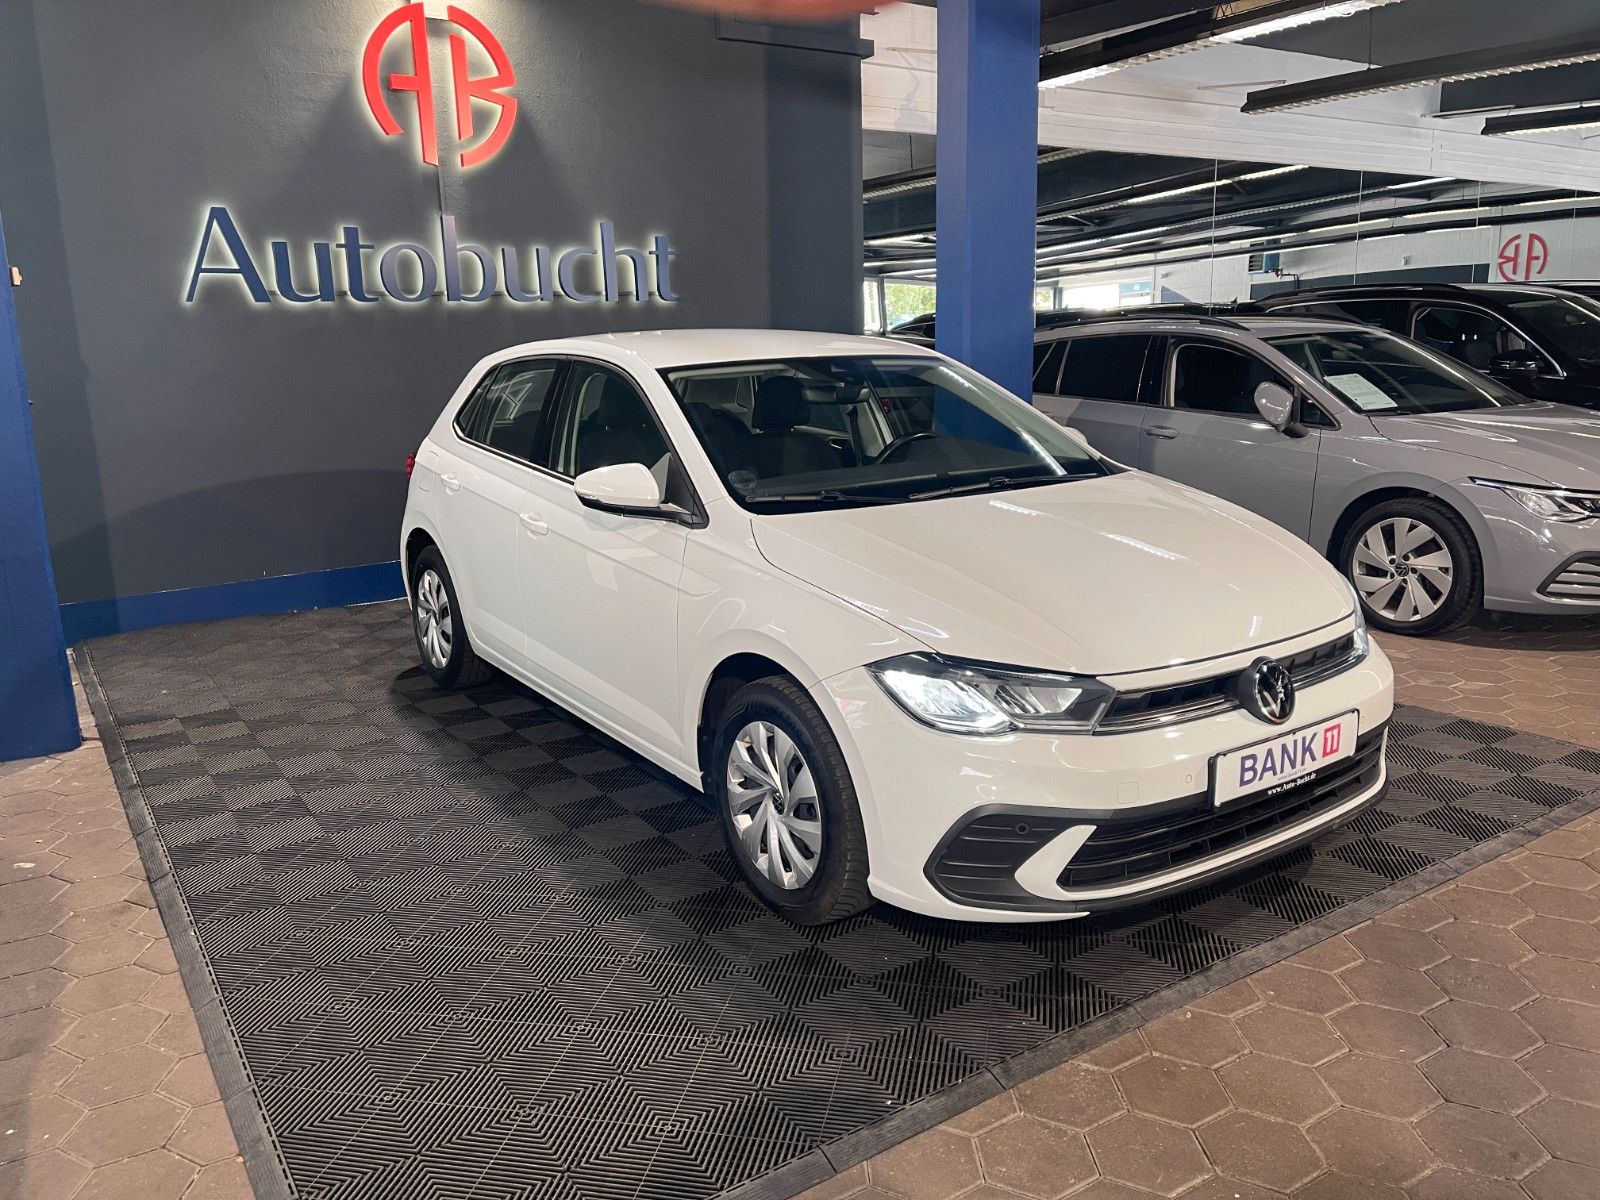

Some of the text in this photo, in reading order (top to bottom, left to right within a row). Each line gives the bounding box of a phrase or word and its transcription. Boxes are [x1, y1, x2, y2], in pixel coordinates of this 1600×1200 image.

[362, 2, 518, 168] AB
[186, 206, 681, 303] Autobucht
[1239, 727, 1339, 788] BANK 11
